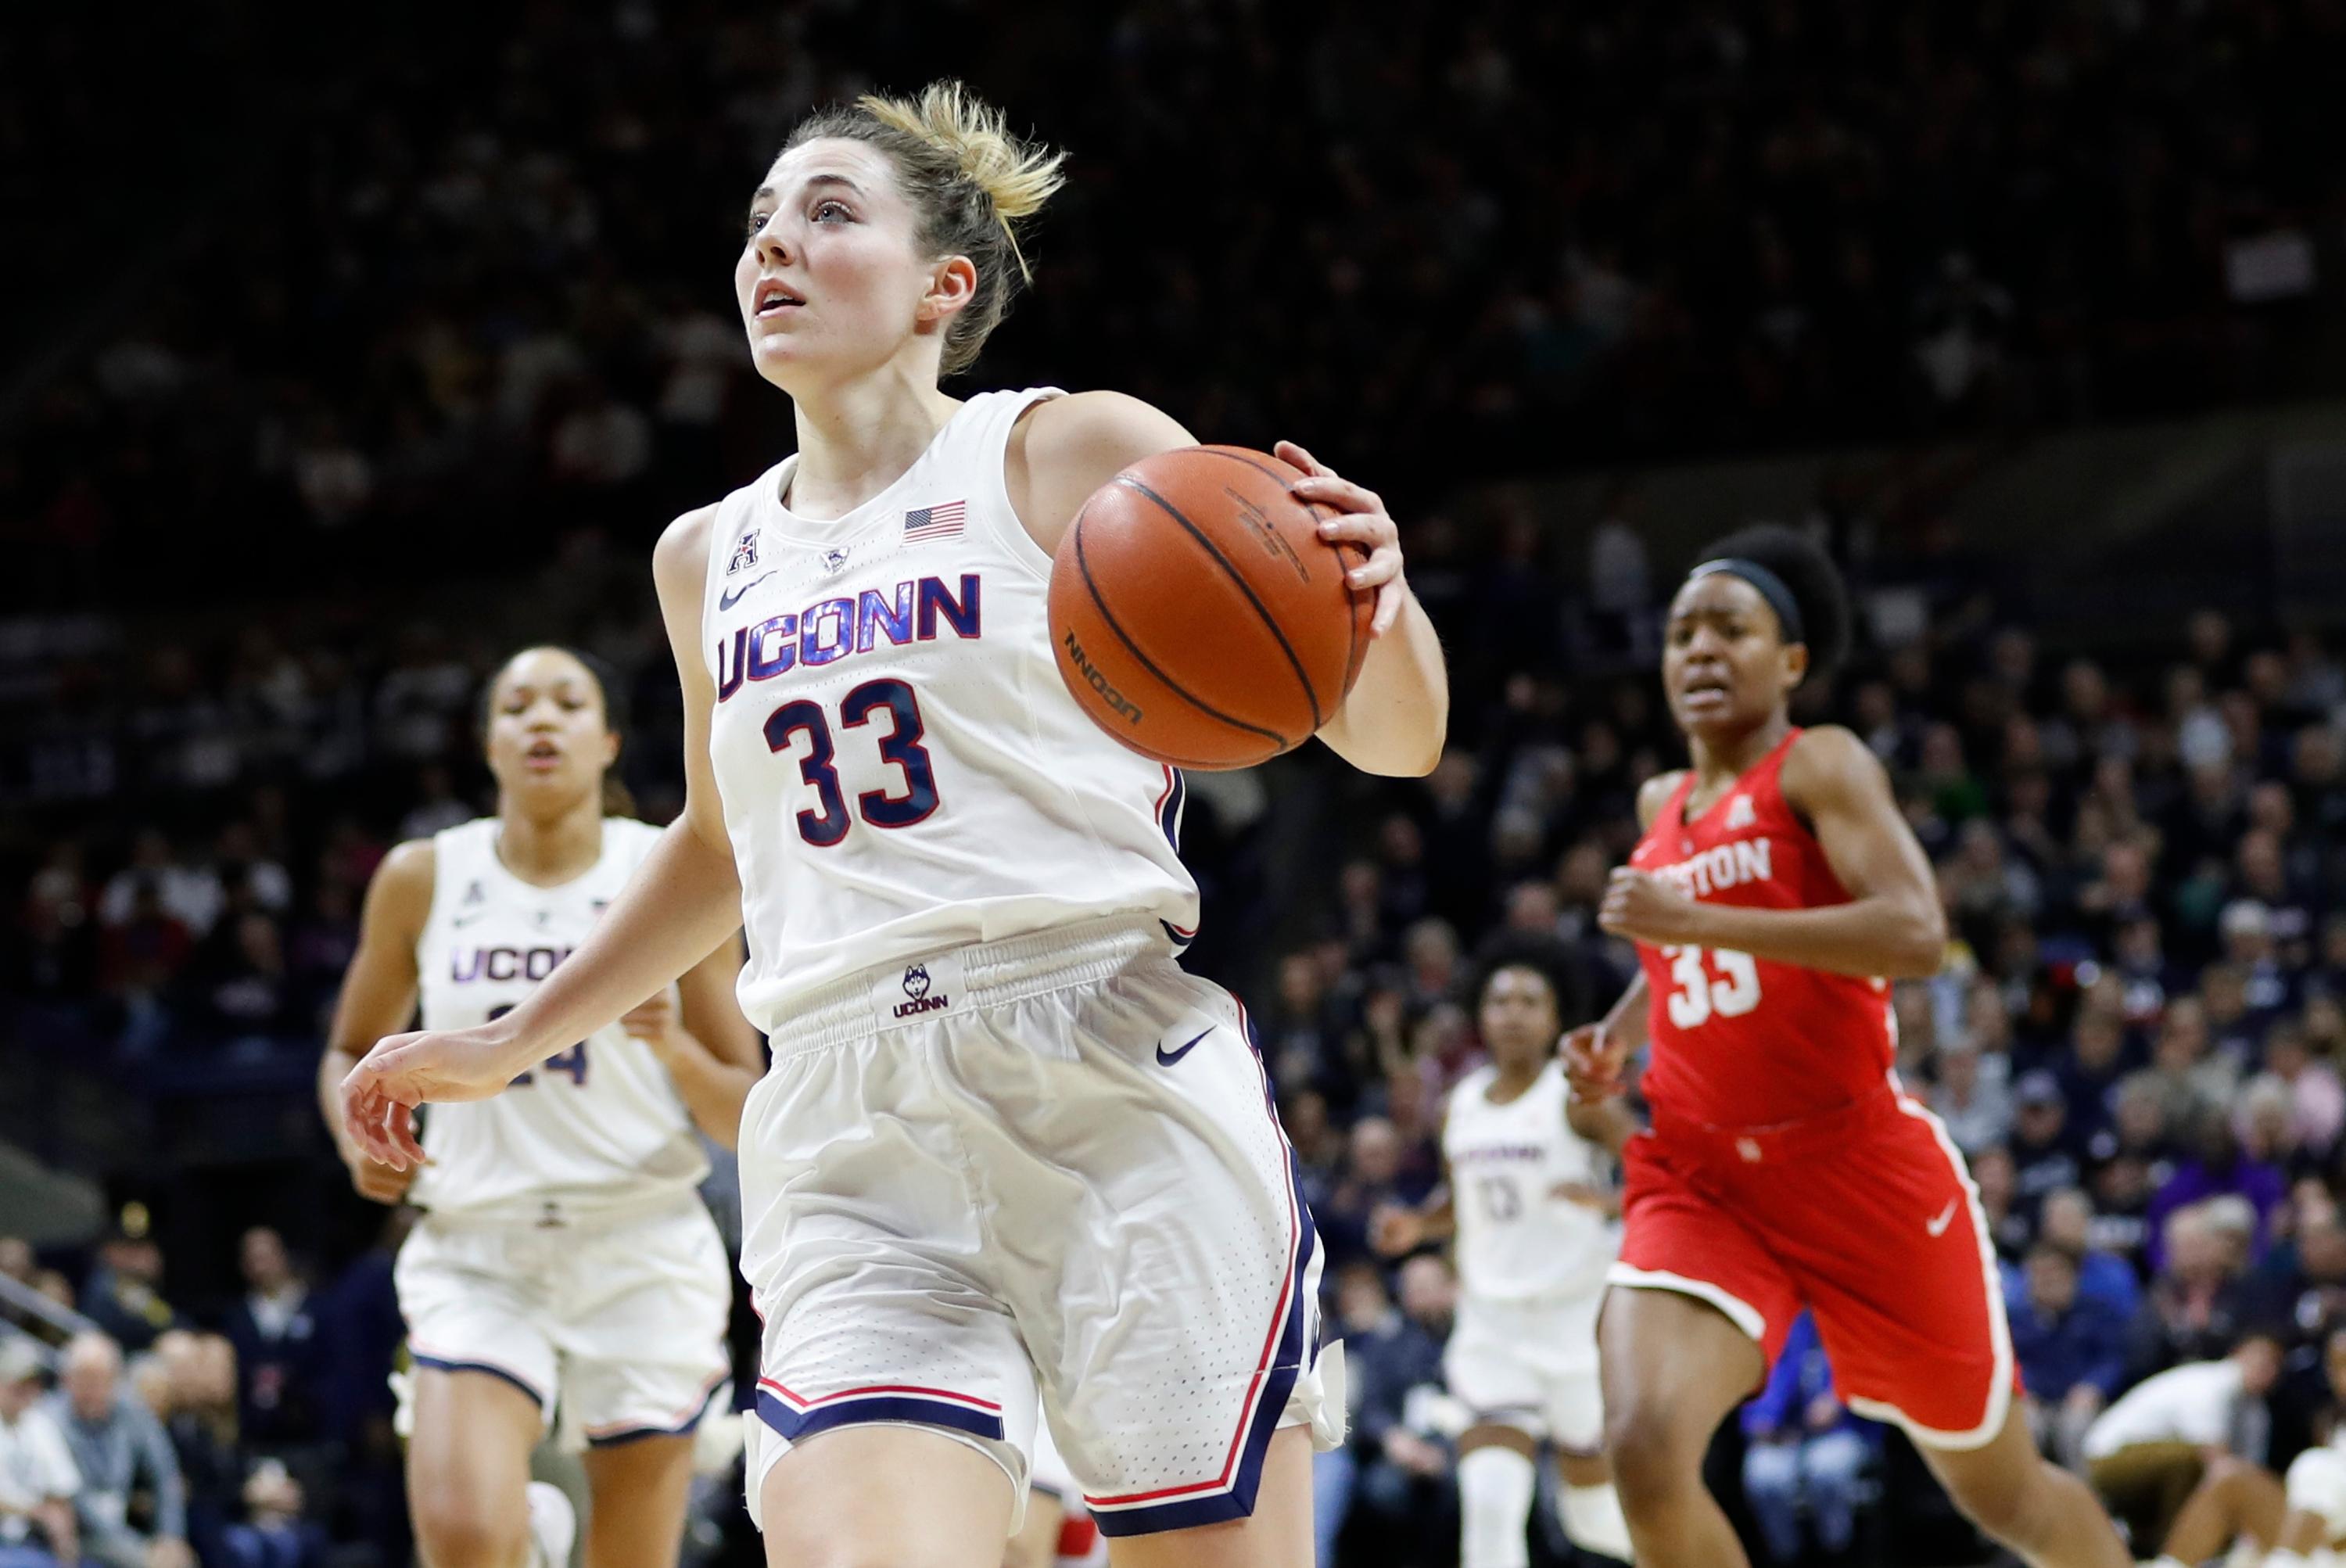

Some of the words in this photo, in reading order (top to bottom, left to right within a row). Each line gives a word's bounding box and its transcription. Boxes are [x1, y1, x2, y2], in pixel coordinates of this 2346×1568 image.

[718, 574, 981, 703] UCONN
[1065, 627, 1143, 726] UCONN
[763, 678, 939, 847] 33
[893, 994, 949, 1018] UCONN
